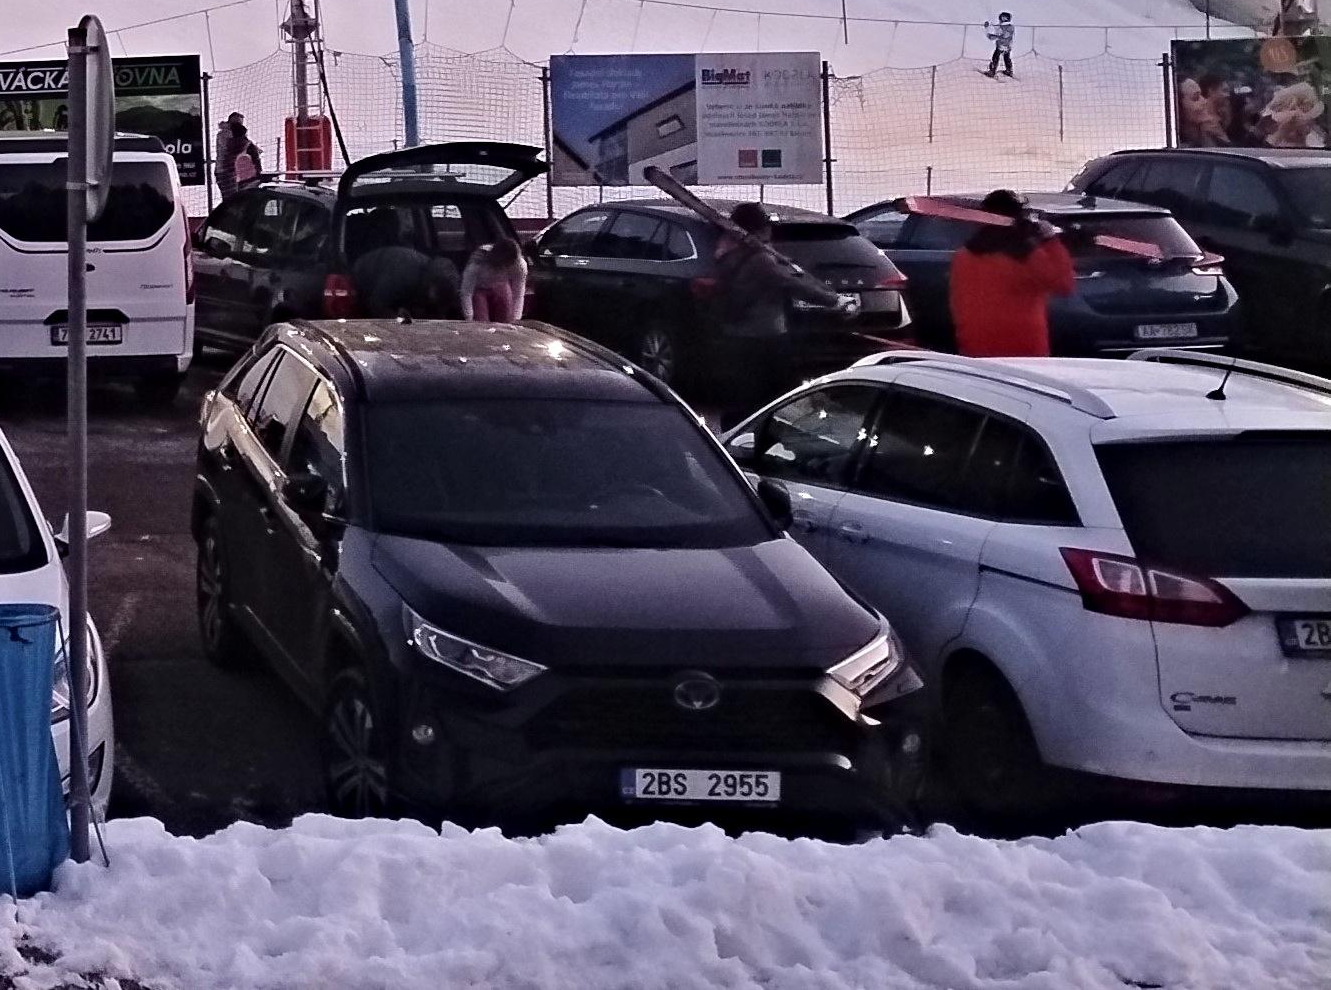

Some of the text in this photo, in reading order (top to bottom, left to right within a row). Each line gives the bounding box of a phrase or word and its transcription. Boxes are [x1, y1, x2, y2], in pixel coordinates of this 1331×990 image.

[701, 68, 751, 84] BigMat
[165, 139, 192, 154] ola
[89, 328, 116, 340] 2741
[642, 773, 687, 796] 2BS
[707, 773, 769, 797] 2955
